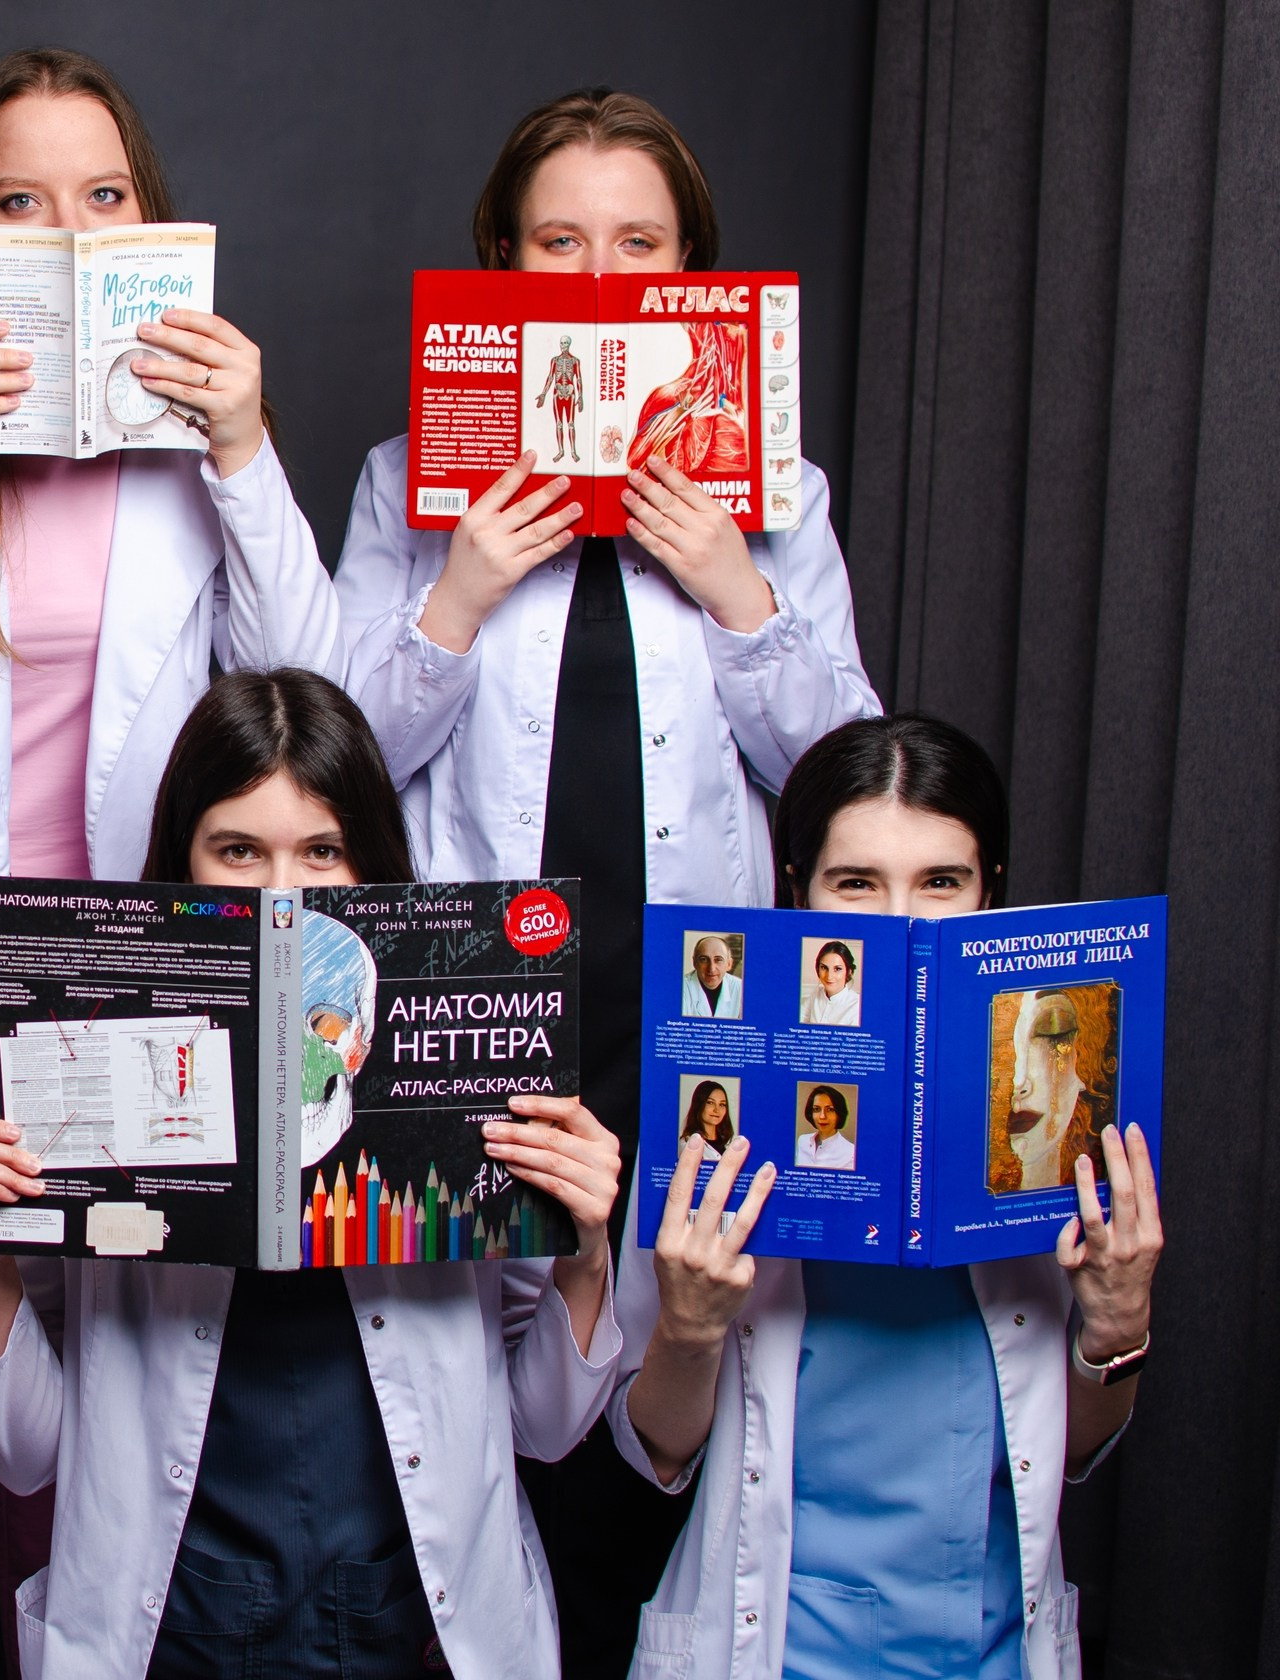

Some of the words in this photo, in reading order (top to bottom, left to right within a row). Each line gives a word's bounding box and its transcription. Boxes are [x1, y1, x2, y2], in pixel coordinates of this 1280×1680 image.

[640, 286, 748, 312] АТЛАС
[424, 324, 516, 347] АТЛАС
[423, 345, 516, 361] АНАТОМИИ
[423, 359, 516, 373] ЧЕЛОВЕКА
[616, 339, 625, 400] АТЛАС
[61, 896, 113, 909] НЕТТЕРА:
[116, 899, 157, 912] АТЛАС-
[173, 902, 252, 917] РАСКРАСКА
[345, 903, 390, 916] ДЖОН
[396, 902, 408, 913] Т.
[414, 901, 473, 912] ХАНСЕН
[523, 903, 546, 914] БОЛЕЕ
[124, 914, 164, 922] ХАНСЕН
[375, 922, 406, 930] JOHN
[411, 921, 419, 929] T.
[425, 919, 471, 931] HANSEN
[520, 912, 554, 932] 600
[520, 930, 560, 944] РИСУНКОВ
[961, 923, 1148, 956] КОСМЕТОЛОГИЧЕСКАЯ
[977, 950, 1076, 974] АНАТОМИЯ
[1084, 945, 1132, 963] ЛИЦА
[916, 966, 927, 1001] ЛИЦА
[388, 992, 561, 1021] АНАТОМИЯ
[277, 991, 286, 1055] АНАТОМИЯ
[394, 1027, 552, 1062] НЕТТЕРА
[914, 1007, 925, 1076] АНАТОМИЯ
[276, 1059, 286, 1108] НЕТТЕРА:
[390, 1076, 553, 1096] АТЛАС-РАСКРАСКА
[477, 1114, 512, 1122] ИЗДАНИЕ
[910, 1082, 923, 1217] КОСМЕТОЛОГИЧЕСКАЯ
[275, 1112, 285, 1213] АТЛАС-РАСКРАСКА
[954, 1223, 986, 1232] Воробьев
[1049, 1211, 1078, 1220] Пылаева
